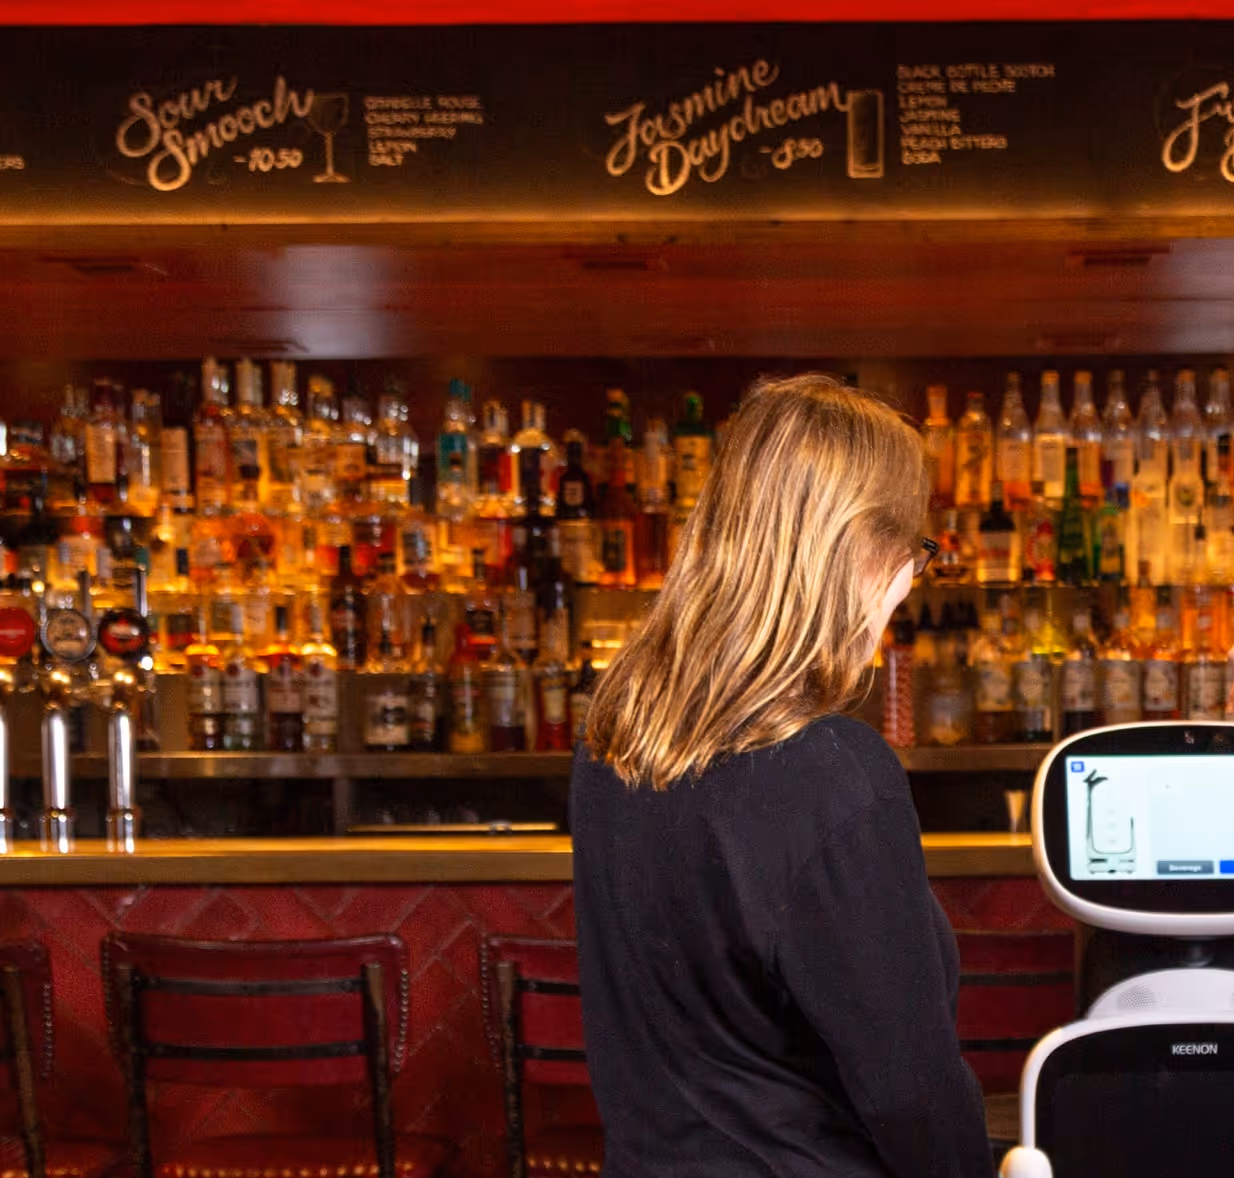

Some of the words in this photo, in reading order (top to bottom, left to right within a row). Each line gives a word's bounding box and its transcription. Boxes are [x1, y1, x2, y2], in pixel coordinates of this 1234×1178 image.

[116, 76, 238, 157] Sour
[147, 75, 315, 191] Smooch
[604, 59, 779, 176] Jasmine
[645, 80, 849, 196] Daydream
[1171, 1043, 1218, 1055] KEENON
